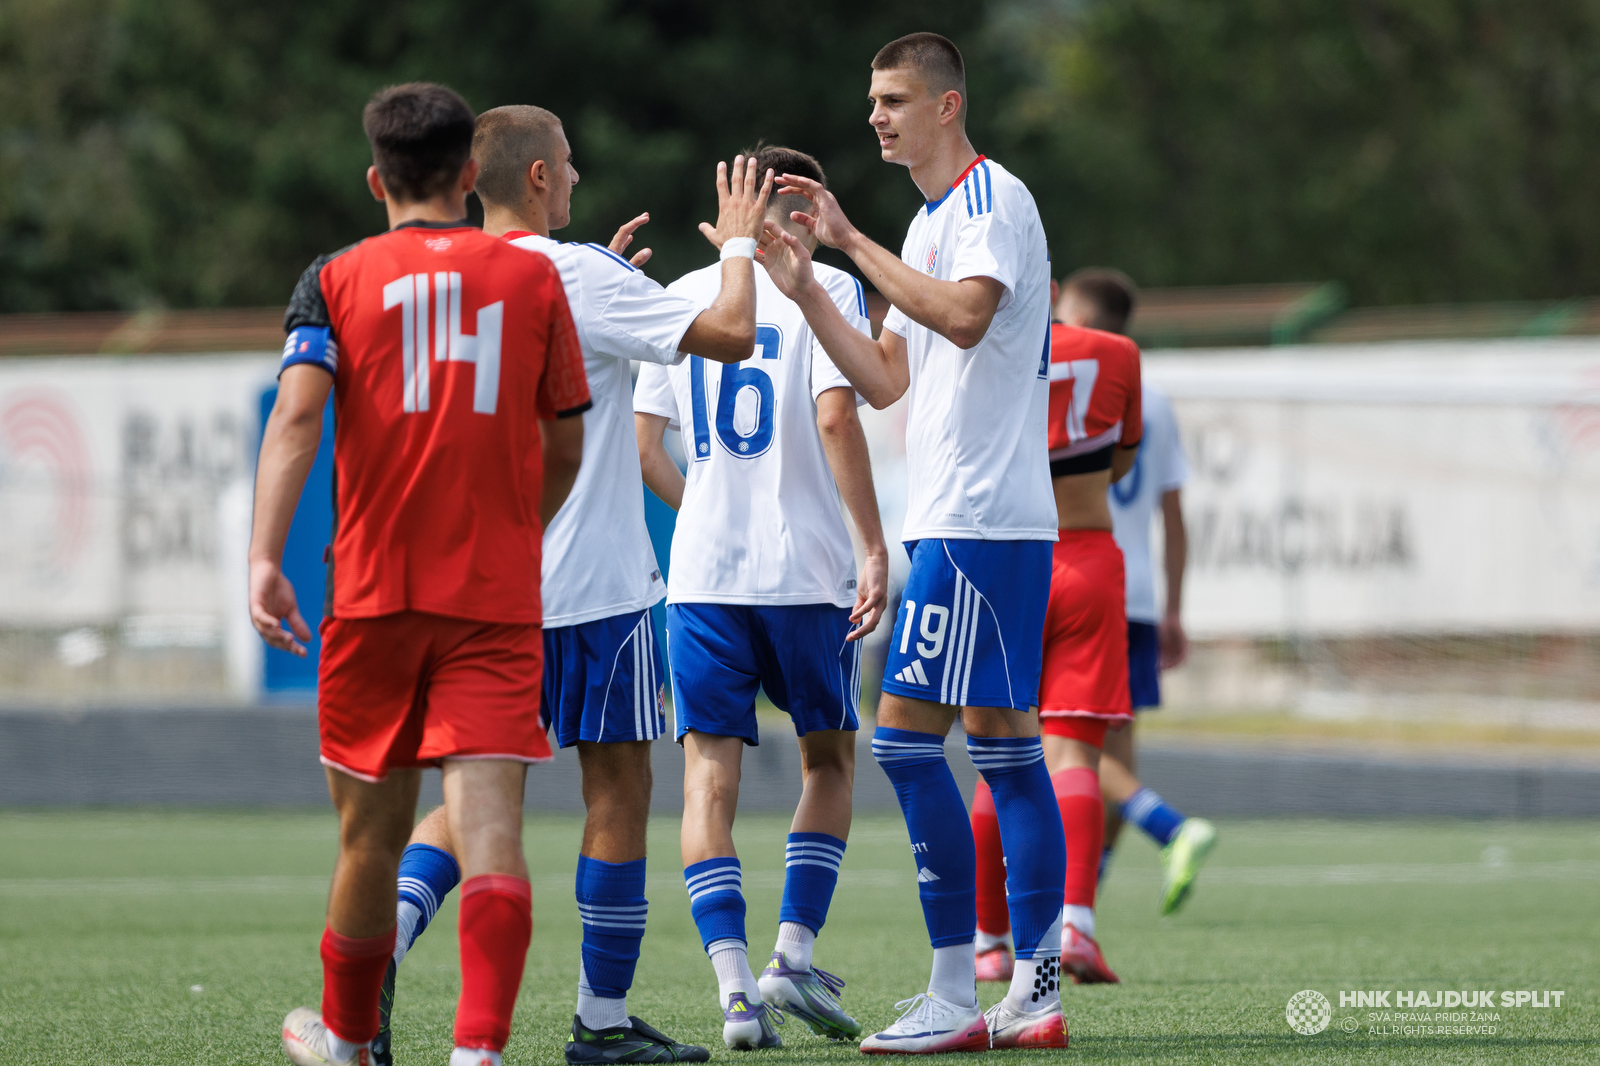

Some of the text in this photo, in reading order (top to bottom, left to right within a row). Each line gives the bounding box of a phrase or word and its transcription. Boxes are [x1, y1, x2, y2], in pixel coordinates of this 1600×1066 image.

[383, 271, 504, 415] 14
[687, 322, 784, 463] 16
[899, 599, 950, 660] 19
